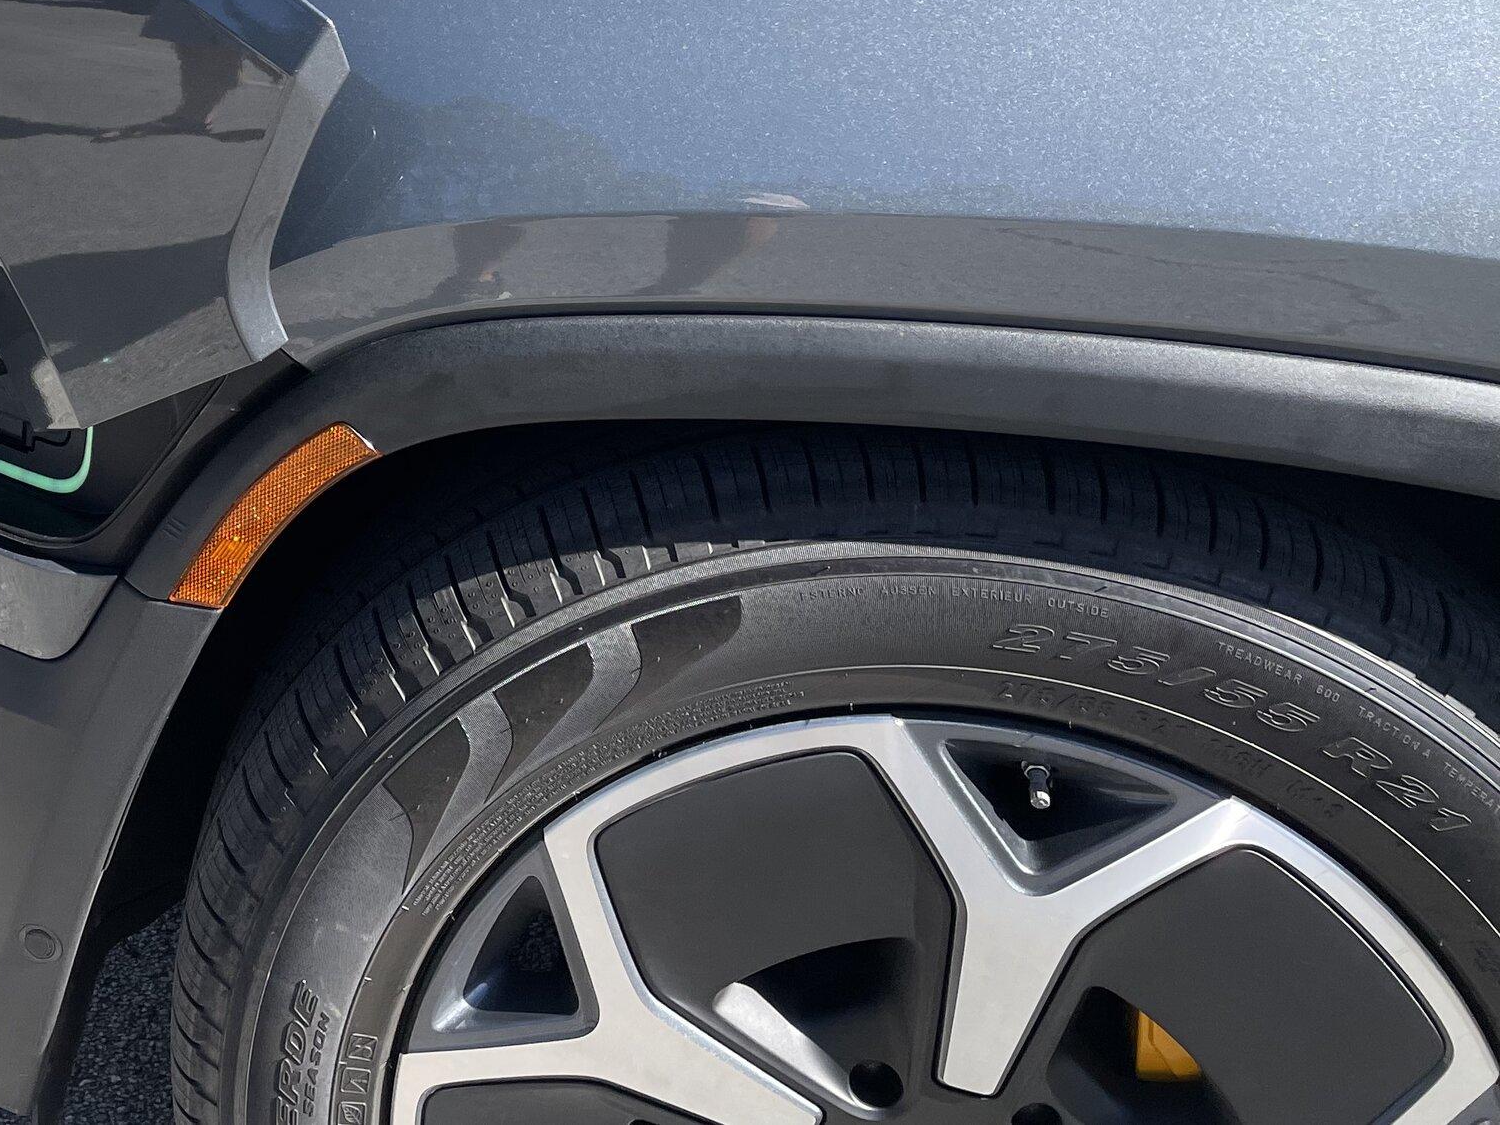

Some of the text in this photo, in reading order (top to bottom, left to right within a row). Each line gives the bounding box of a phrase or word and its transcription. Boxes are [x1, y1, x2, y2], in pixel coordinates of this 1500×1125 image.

[952, 586, 1033, 605] EXTERIEUR
[1047, 598, 1109, 619] OUTSIDE
[1218, 641, 1304, 686] TREADWEAR
[1316, 684, 1341, 703] 600
[992, 623, 1322, 733] 275/55
[1322, 736, 1473, 832] R21
[302, 1011, 331, 1118] SEASON
